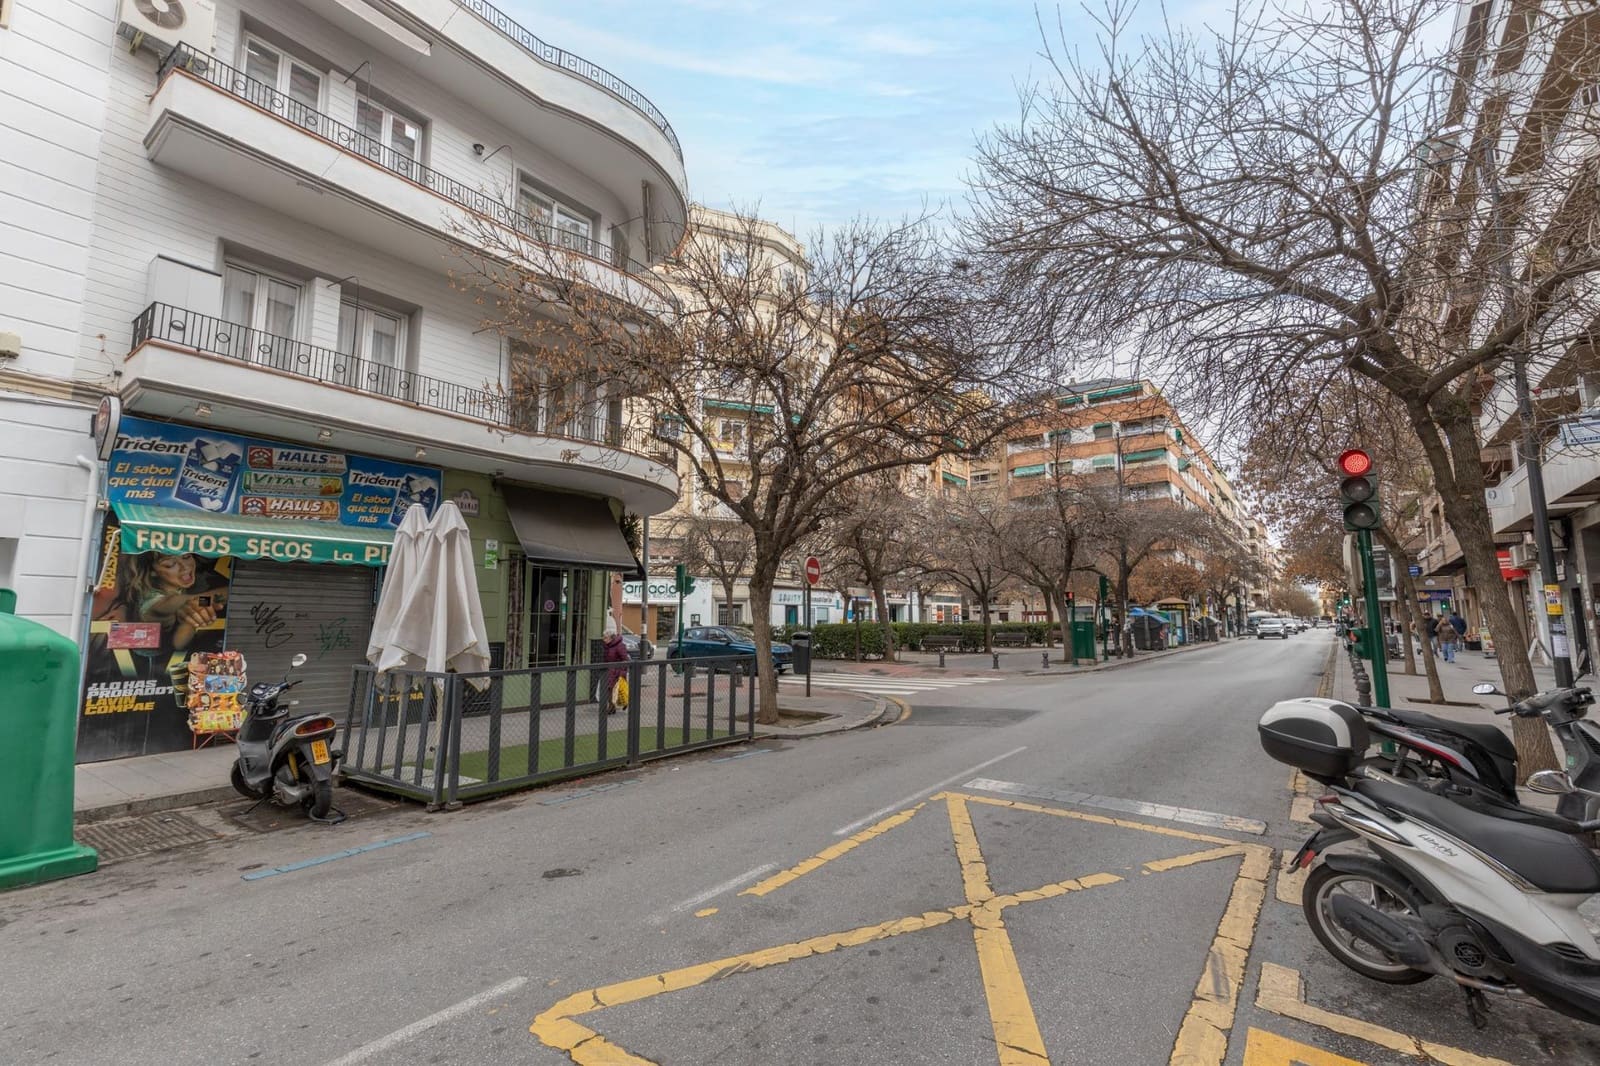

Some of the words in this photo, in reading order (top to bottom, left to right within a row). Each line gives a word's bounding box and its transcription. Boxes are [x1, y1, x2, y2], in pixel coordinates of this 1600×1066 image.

[116, 436, 188, 454] Trident
[277, 451, 328, 464] HALLS
[115, 462, 130, 473] El
[132, 464, 176, 475] sabor
[108, 477, 139, 488] que
[141, 477, 175, 487] dura
[183, 467, 228, 487] Trident
[352, 472, 401, 487] Trident
[125, 487, 156, 499] más
[352, 493, 363, 503] El
[364, 494, 392, 504] sabor
[270, 500, 323, 512] HALLS
[347, 504, 368, 513] que
[368, 505, 392, 514] dura
[358, 515, 379, 523] más
[136, 529, 231, 555] FRUTOS
[246, 538, 313, 559] SECOS
[333, 550, 353, 561] La
[123, 680, 158, 689] HAS
[86, 686, 174, 699] PROBADO?
[84, 702, 156, 716] COMPAE
